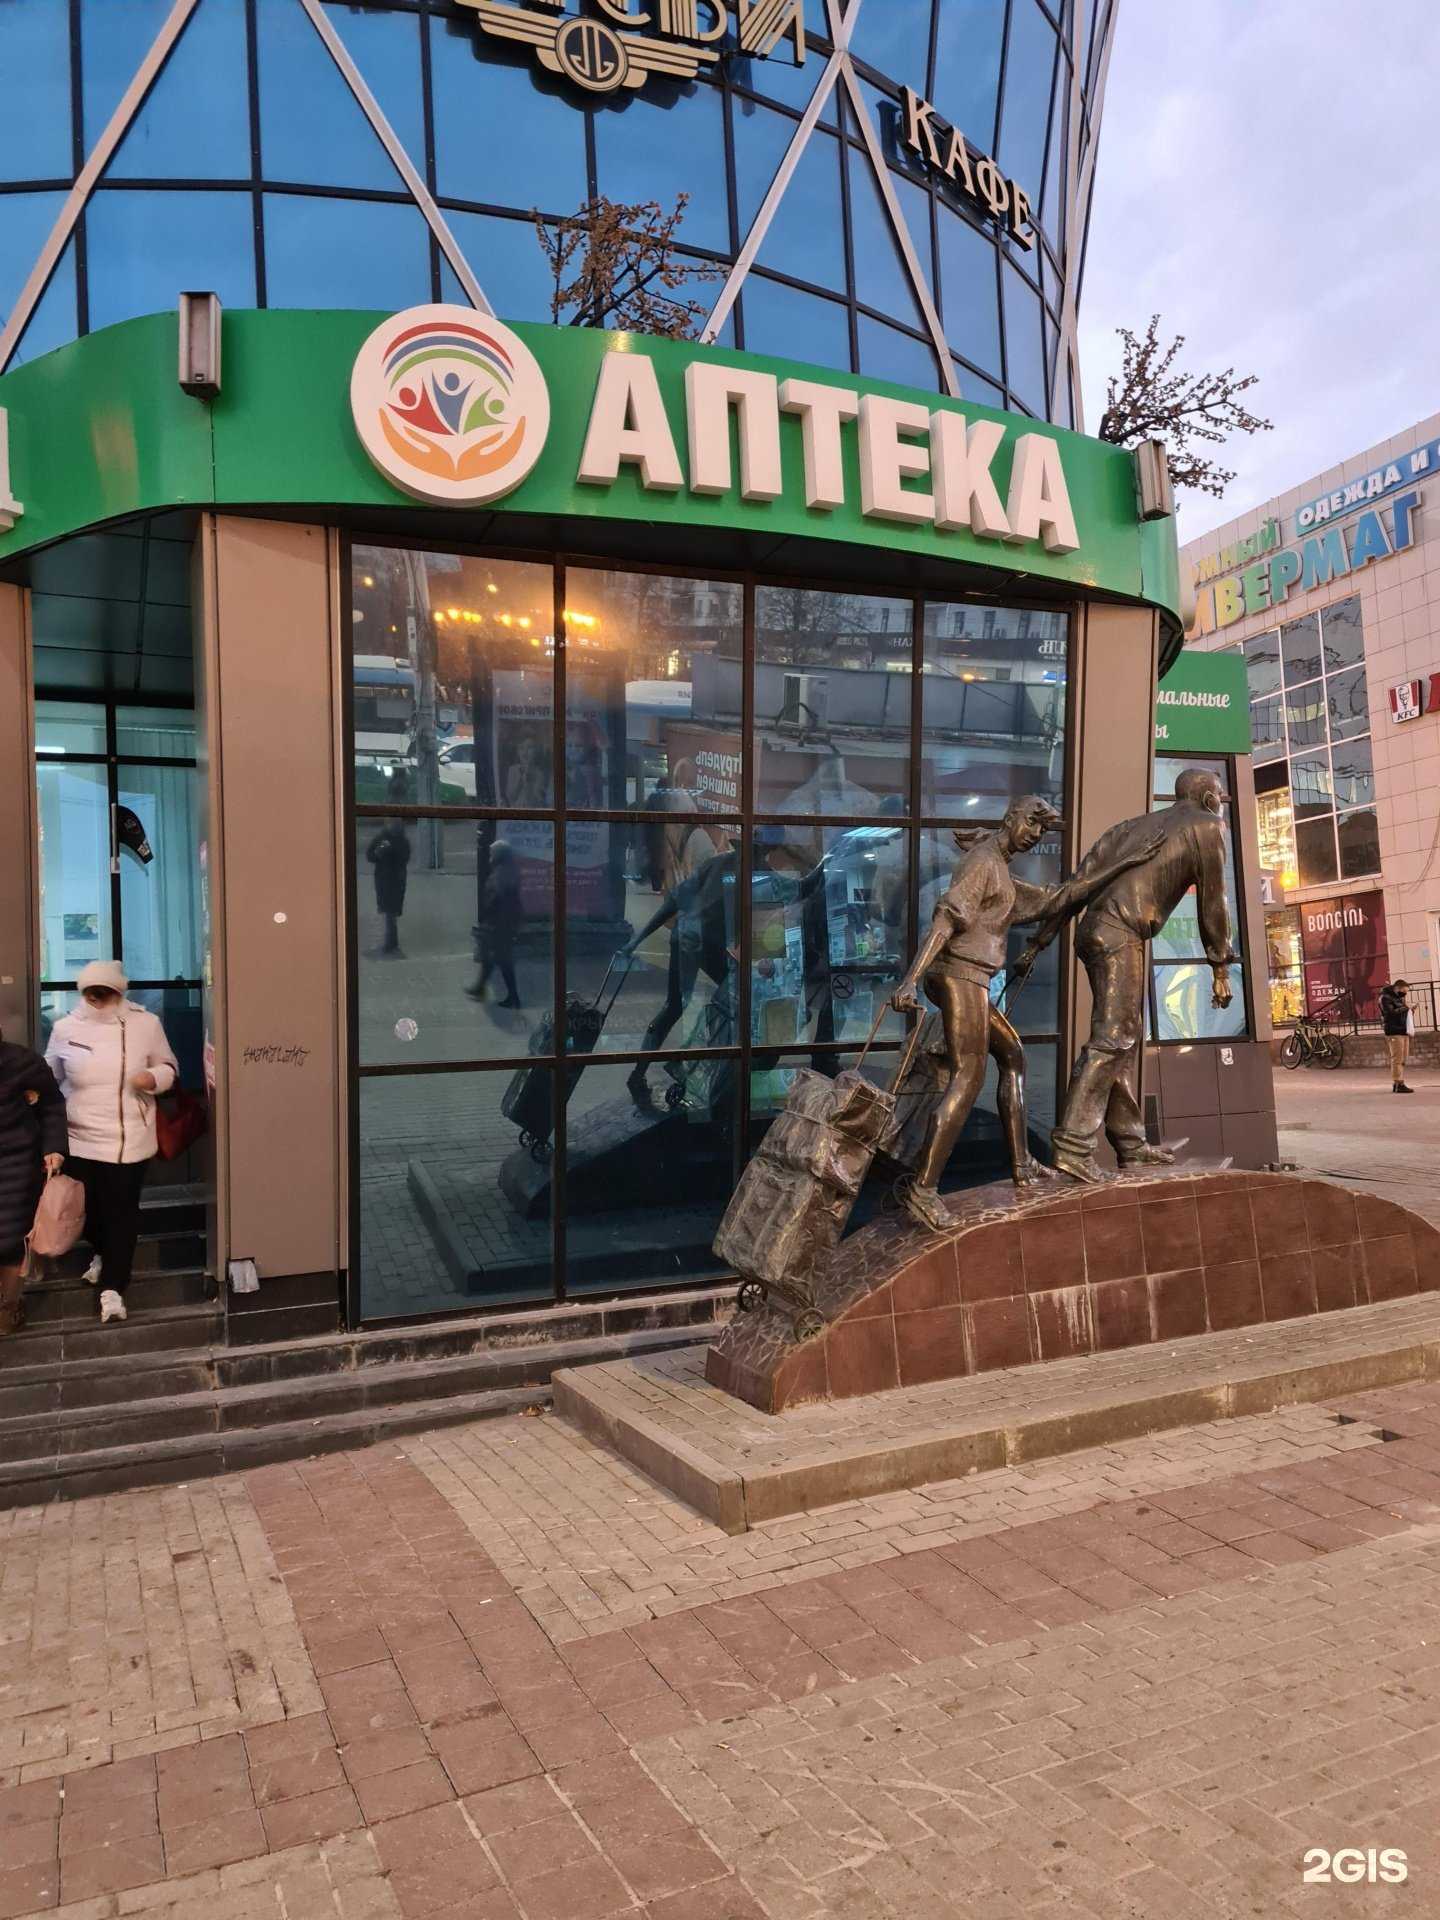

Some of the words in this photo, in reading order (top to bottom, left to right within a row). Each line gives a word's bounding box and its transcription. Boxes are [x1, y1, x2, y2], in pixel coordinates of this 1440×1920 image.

[904, 84, 1036, 250] КАФЕ
[577, 351, 1080, 555] АПТЕКА
[1299, 465, 1401, 526] ОДЕЖДА
[1411, 448, 1429, 473] И
[1397, 708, 1416, 720] KFC
[1312, 987, 1346, 996] ОДЕЖДЫ
